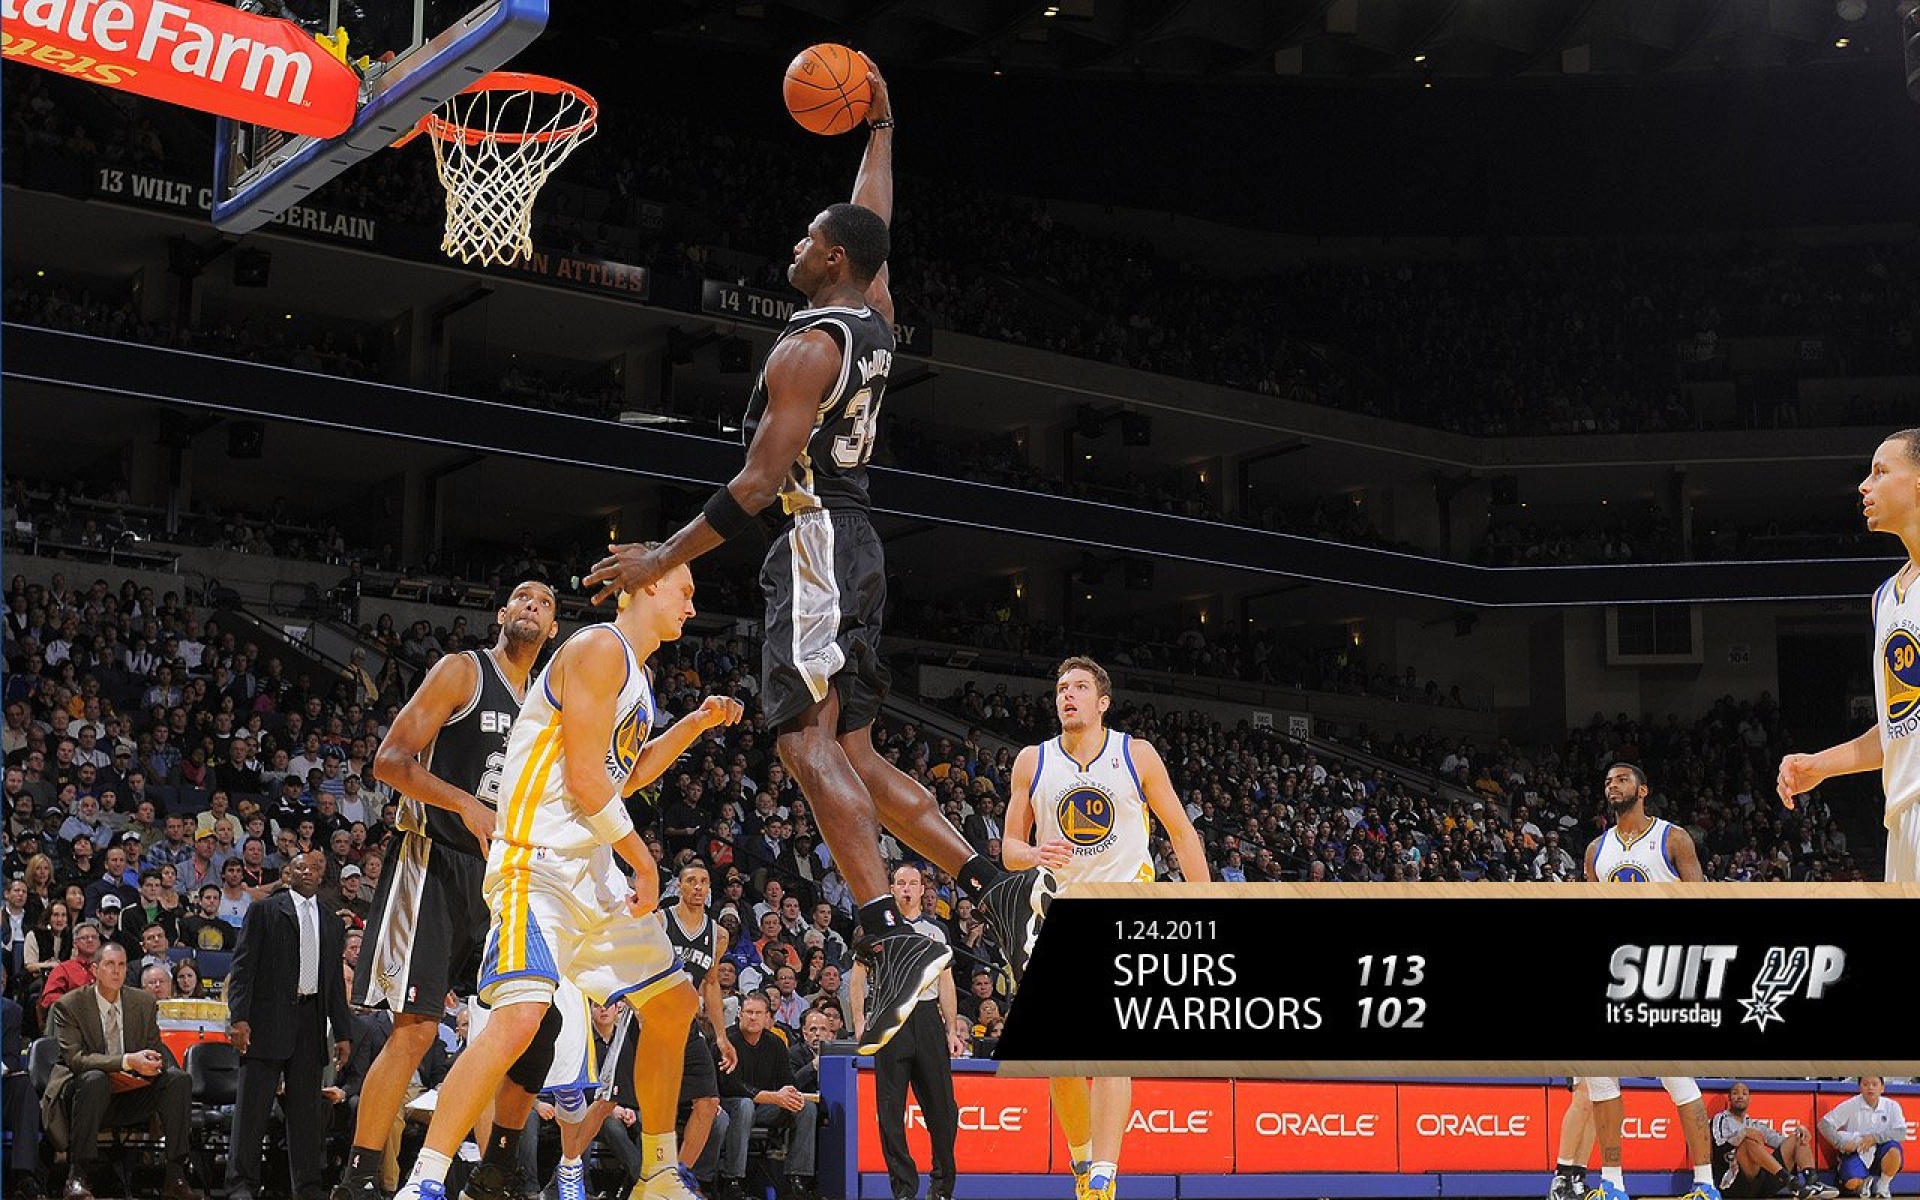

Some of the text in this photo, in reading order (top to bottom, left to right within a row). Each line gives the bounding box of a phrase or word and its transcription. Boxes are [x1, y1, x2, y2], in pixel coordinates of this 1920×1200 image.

[136, 2, 312, 106] Farm
[99, 168, 124, 193] 13
[131, 174, 192, 206] WILT
[557, 257, 644, 292] ATTLES
[719, 289, 796, 321] 14 TOM
[1894, 645, 1914, 671] 30
[476, 751, 506, 804] 2
[1085, 799, 1104, 816] 10
[1072, 833, 1118, 856] RRIORS
[673, 945, 712, 970] PURS
[904, 1105, 1024, 1132] RCLE
[1125, 1109, 1209, 1134] ACLE
[1255, 1112, 1376, 1136] ORACLE
[1416, 1114, 1528, 1136] ORACLE
[1619, 1118, 1669, 1139] CLE
